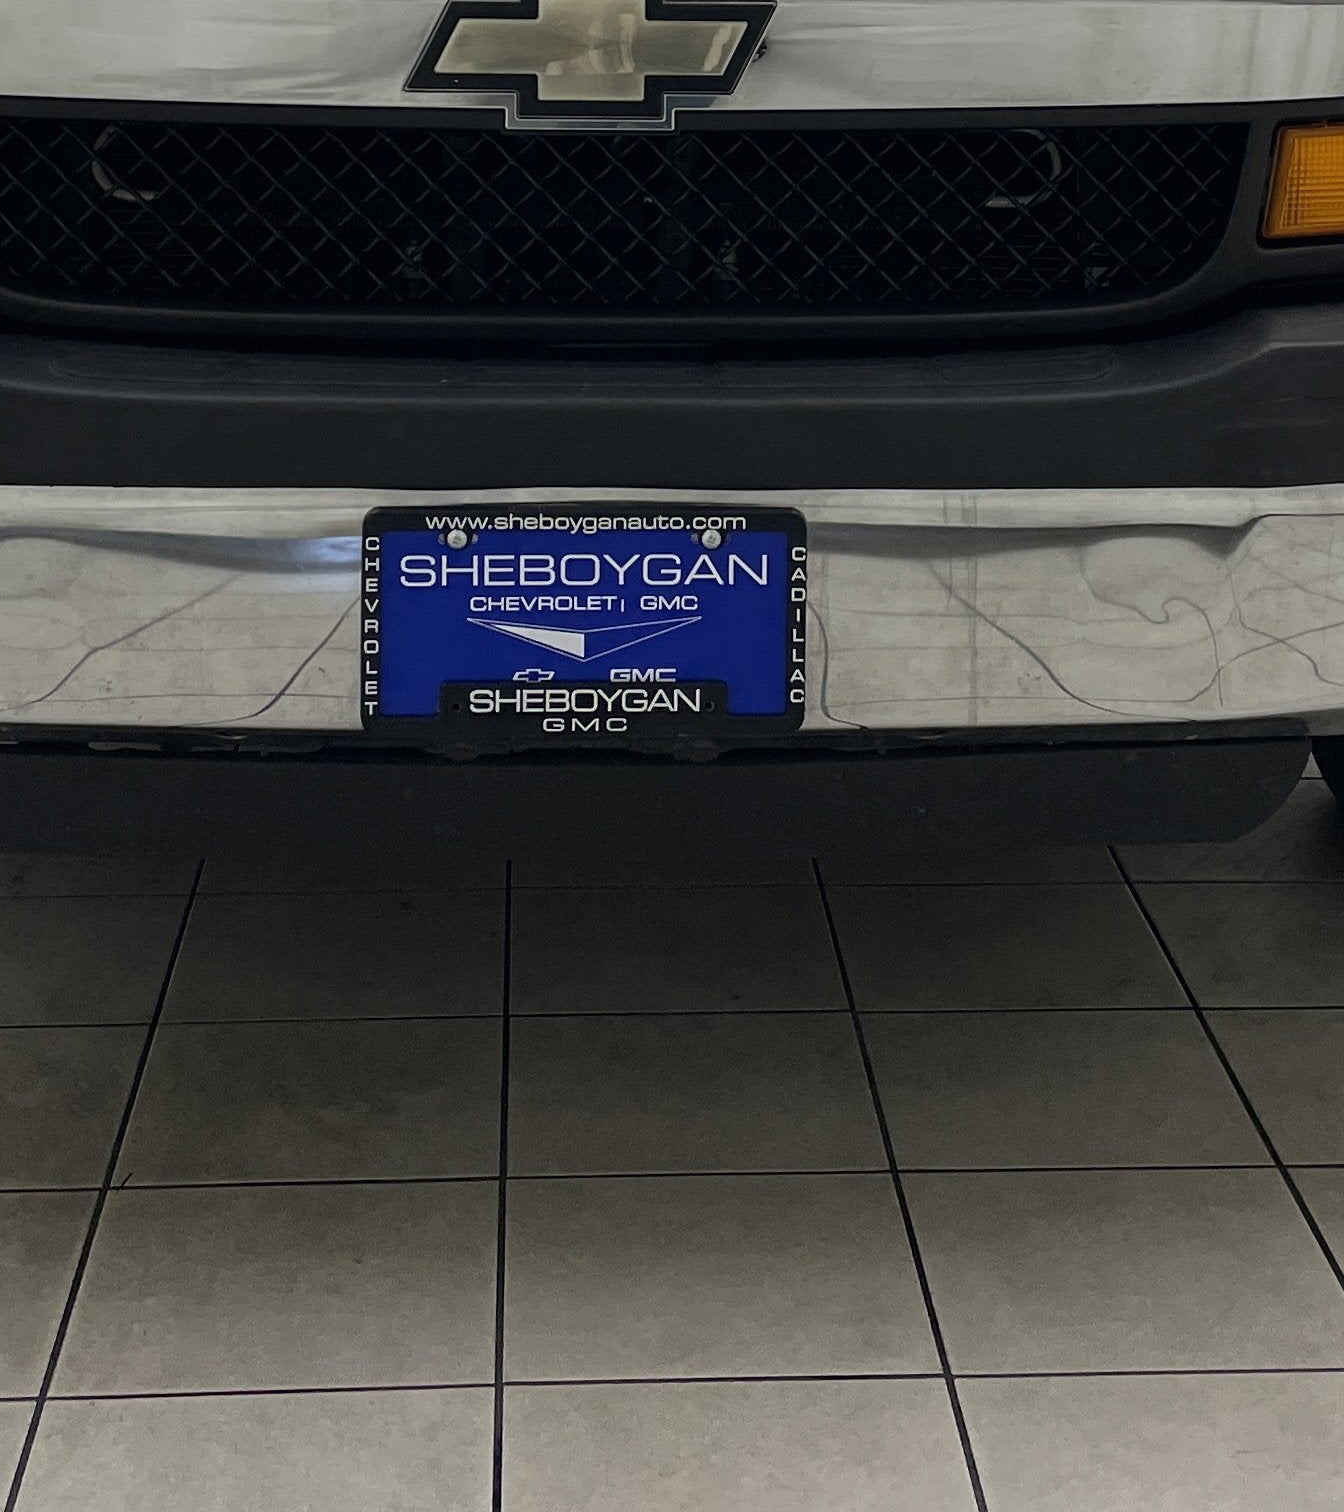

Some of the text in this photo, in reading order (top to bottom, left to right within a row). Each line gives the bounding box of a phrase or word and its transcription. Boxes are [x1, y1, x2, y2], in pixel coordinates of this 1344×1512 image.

[425, 513, 747, 534] www.sheboyganauto.com
[399, 552, 768, 588] SHEBOYGAN
[639, 595, 699, 611] GMC
[362, 536, 380, 717] CHEVROLET
[789, 545, 807, 704] CADILLAC
[609, 667, 678, 684] GMC
[468, 688, 702, 714] SHEBOYGAN
[542, 717, 628, 733] GMC
